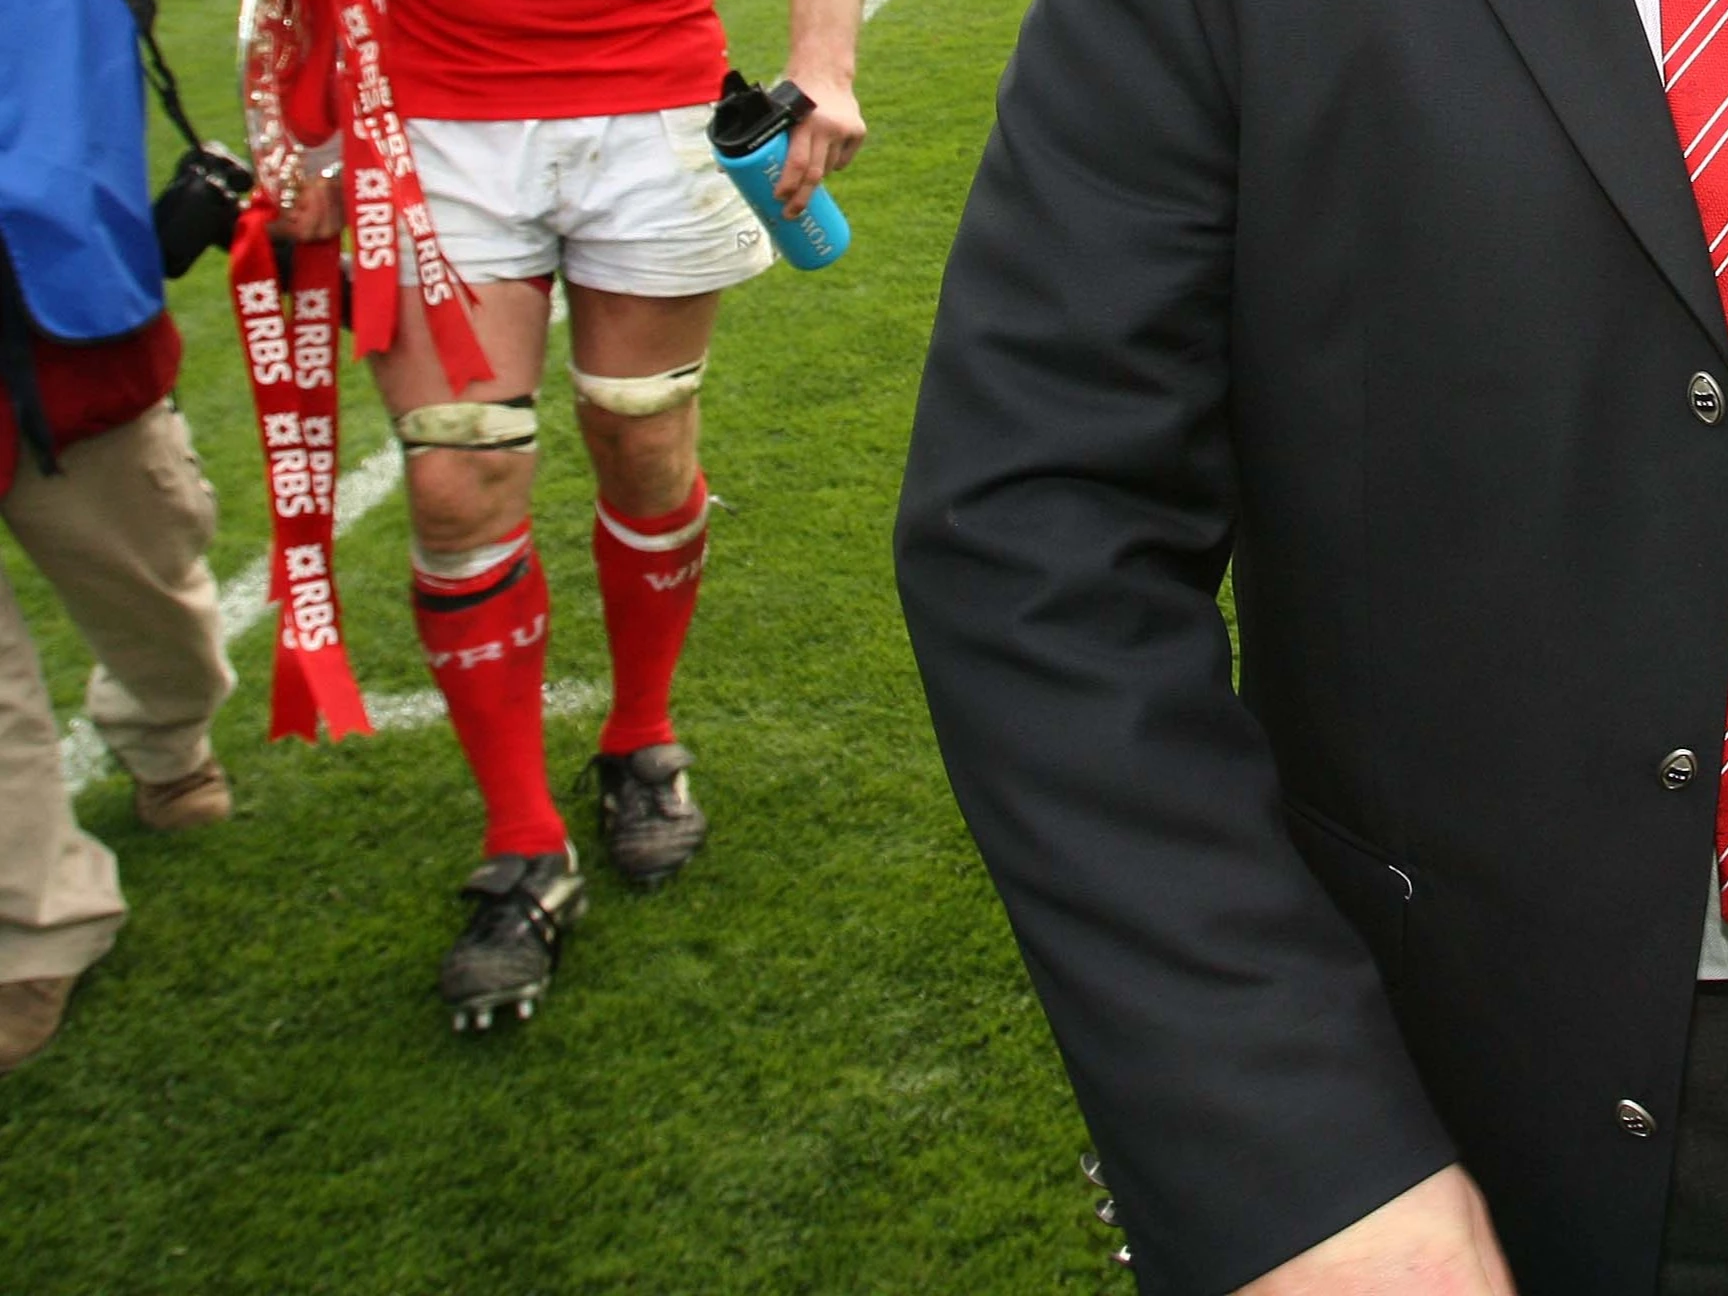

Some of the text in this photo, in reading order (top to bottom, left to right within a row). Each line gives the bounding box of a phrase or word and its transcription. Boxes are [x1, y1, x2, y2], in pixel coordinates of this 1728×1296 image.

[356, 204, 395, 270] RBS
[416, 238, 452, 306] RBS
[245, 315, 292, 386] RBS
[295, 323, 333, 391] RBS
[271, 446, 315, 519] RBS
[292, 580, 339, 653] RBS
